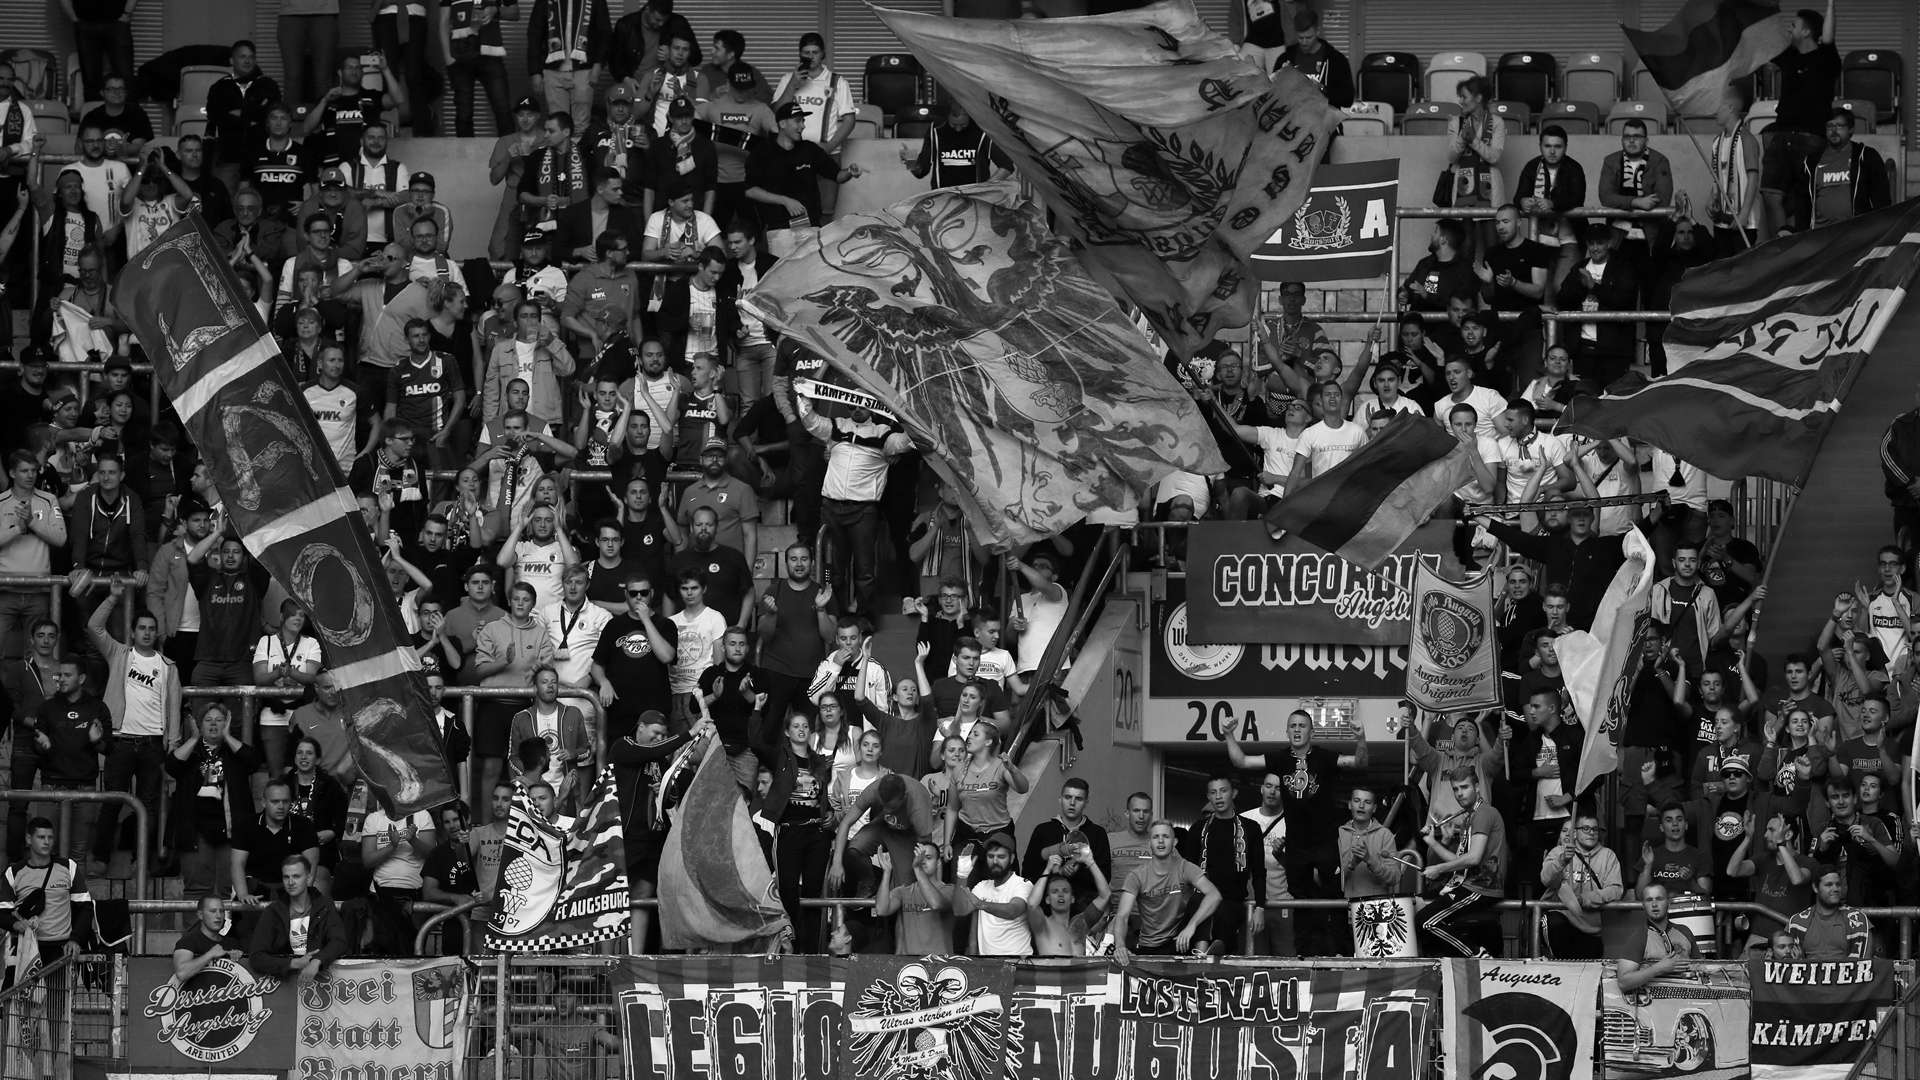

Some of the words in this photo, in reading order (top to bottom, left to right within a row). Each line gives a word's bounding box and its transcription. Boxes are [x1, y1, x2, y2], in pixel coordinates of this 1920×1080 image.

[1823, 171, 1850, 183] WWK
[405, 382, 442, 396] AL-KO
[523, 563, 552, 574] WWK
[128, 667, 156, 687] WWK
[1414, 665, 1486, 689] Augsburger
[1420, 684, 1476, 703] Original
[1186, 701, 1234, 742] 20
[1239, 710, 1259, 742] A
[555, 903, 569, 922] FC
[568, 891, 631, 918] AUGSBURG
[492, 912, 520, 928] 1907
[1480, 966, 1563, 988] Augusta
[1764, 960, 1874, 985] WEITER
[144, 973, 281, 1018] Dissidents
[1120, 970, 1299, 1023] LUSTENAU
[157, 1005, 273, 1043] Augsburg
[880, 1014, 915, 1032] Ultras
[918, 1005, 953, 1024] sterben
[955, 999, 977, 1016] nie!
[301, 1015, 402, 1050] Statt
[618, 988, 844, 1080] LEGIO
[1751, 1018, 1878, 1047] KÄMPFEN
[185, 1046, 203, 1060] ARE
[205, 1044, 240, 1062] UNITED
